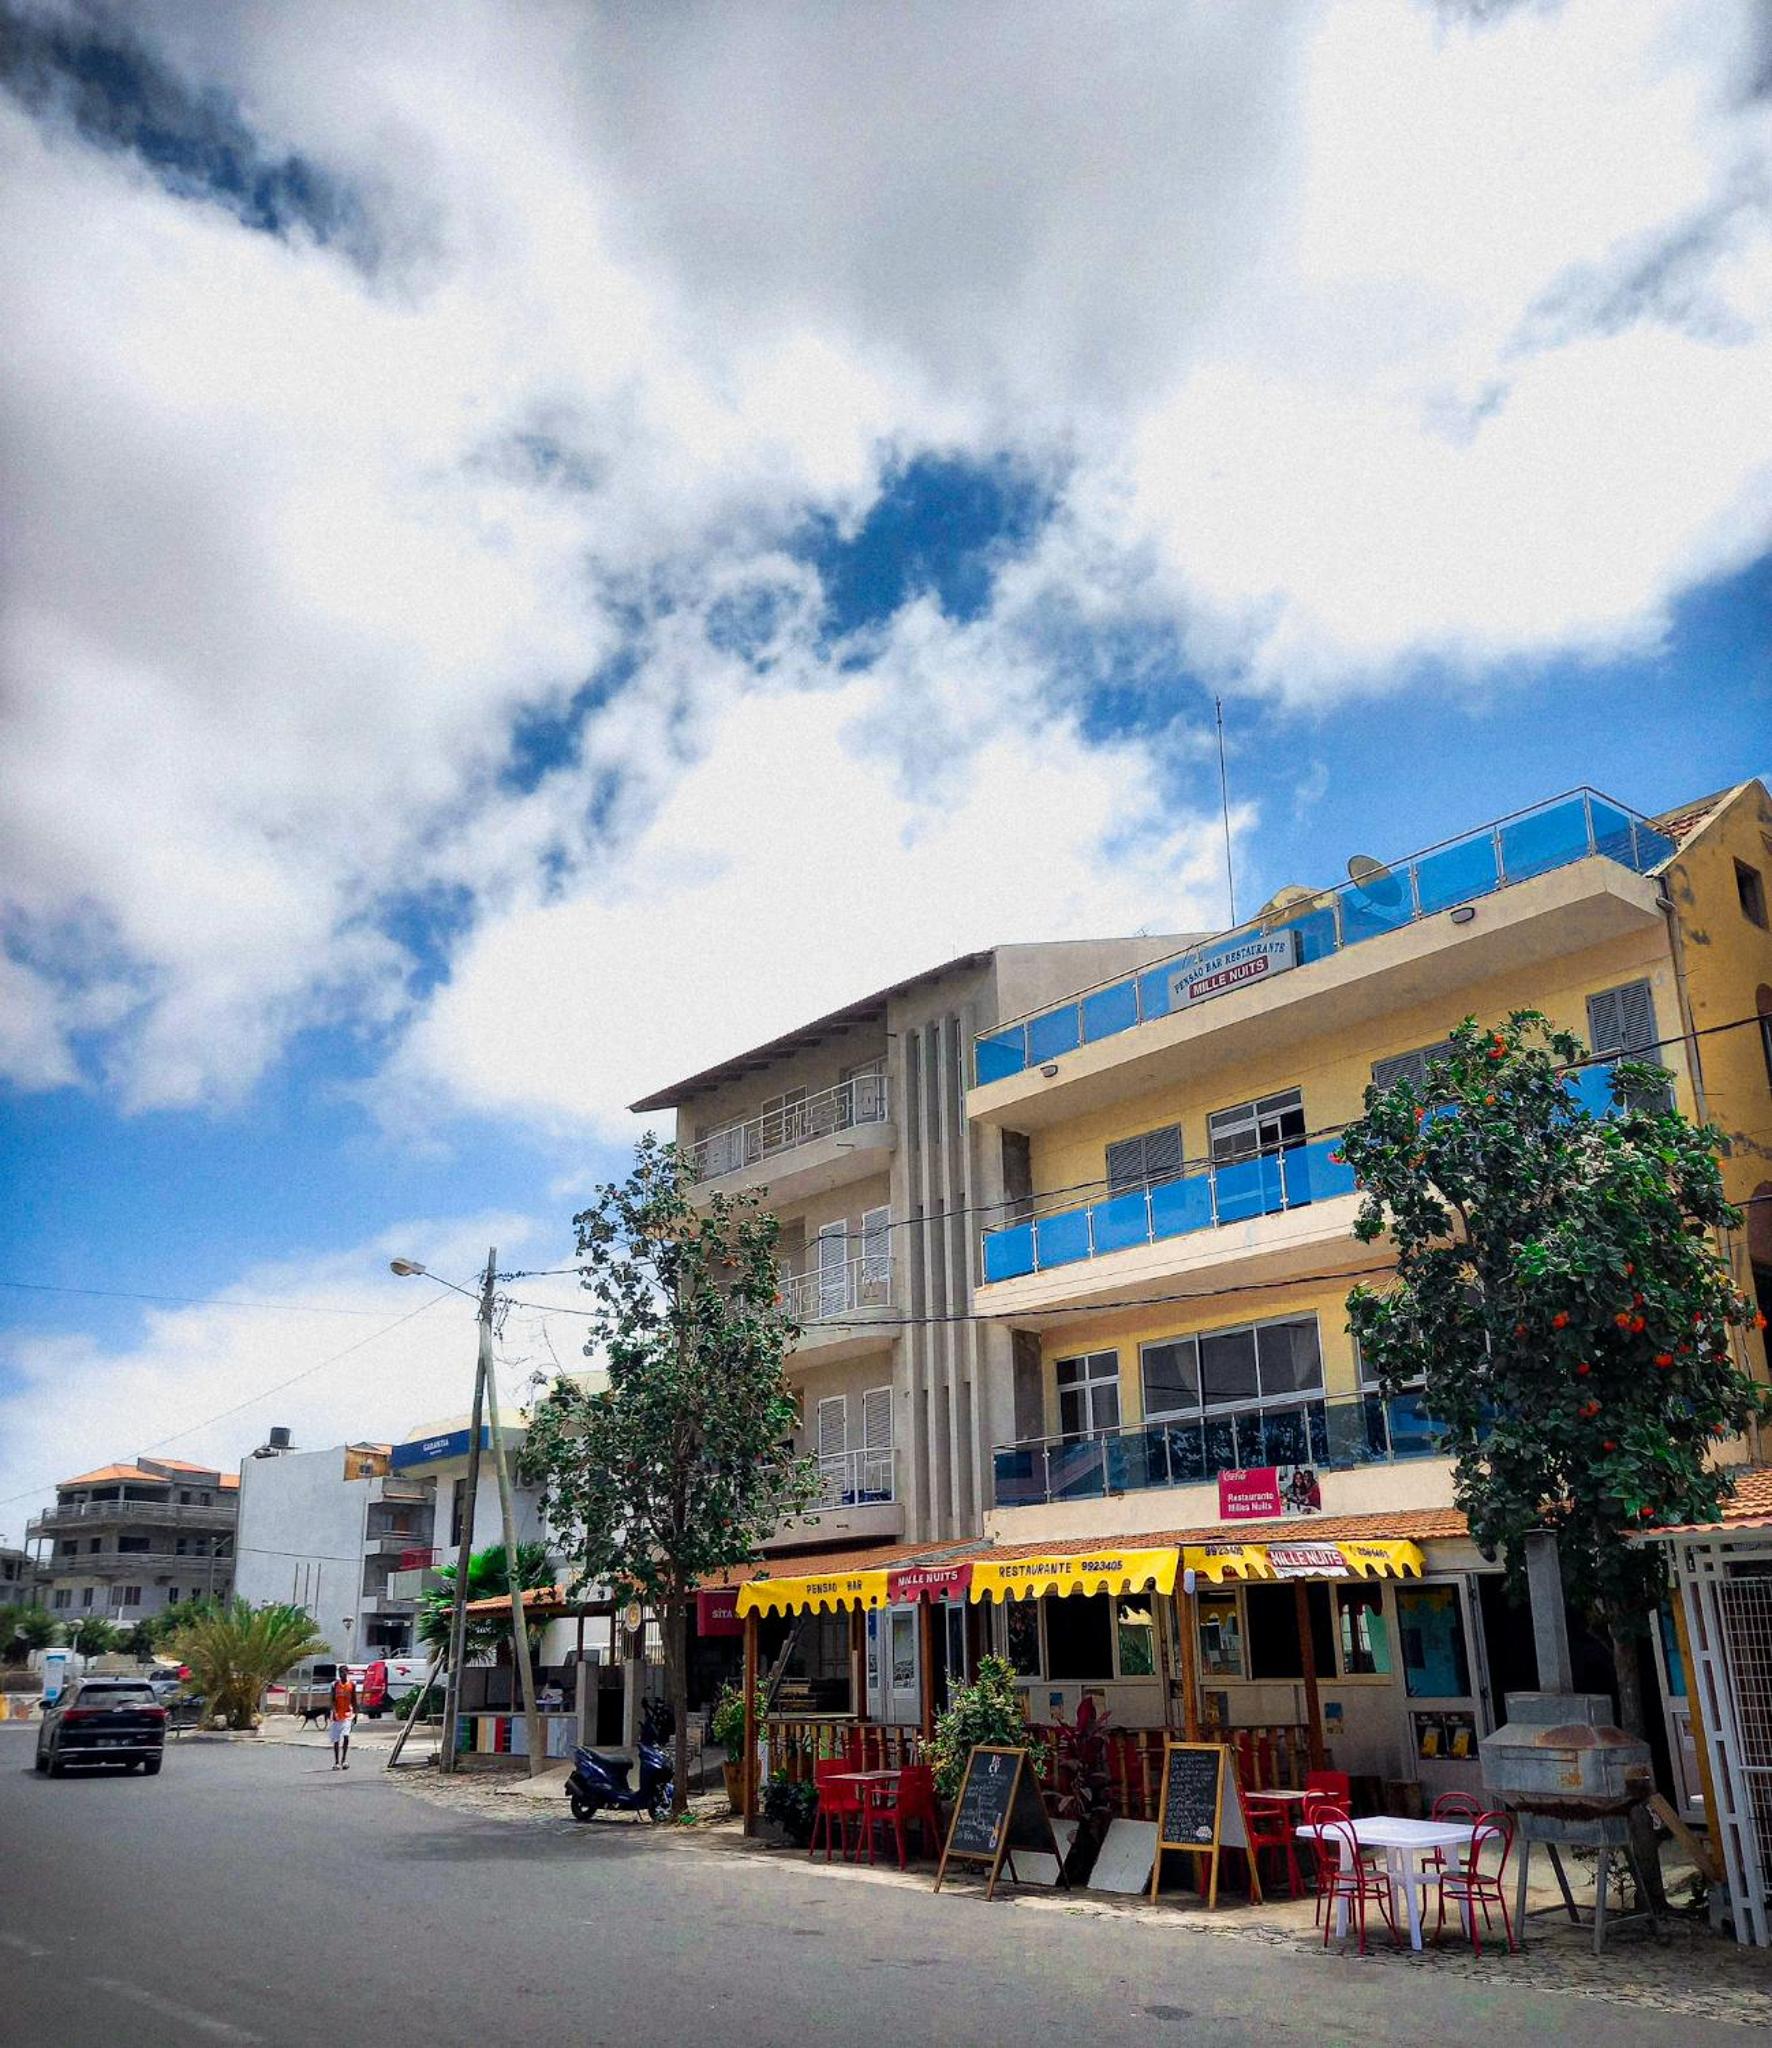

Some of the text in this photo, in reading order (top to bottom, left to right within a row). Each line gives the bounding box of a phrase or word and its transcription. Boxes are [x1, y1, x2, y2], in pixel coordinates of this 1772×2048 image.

[1206, 957, 1223, 973] BAR
[1225, 941, 1286, 965] RESTAURANTE
[1193, 959, 1265, 996] MILLE NUITS
[1228, 1491, 1274, 1503] Restaurante
[1251, 1500, 1273, 1511] Nuits
[1309, 1550, 1346, 1566] NUITS
[999, 1560, 1123, 1578] RESTAURANTE 9923405
[847, 1579, 863, 1591] BAR
[898, 1570, 958, 1587] MILLE NUITS
